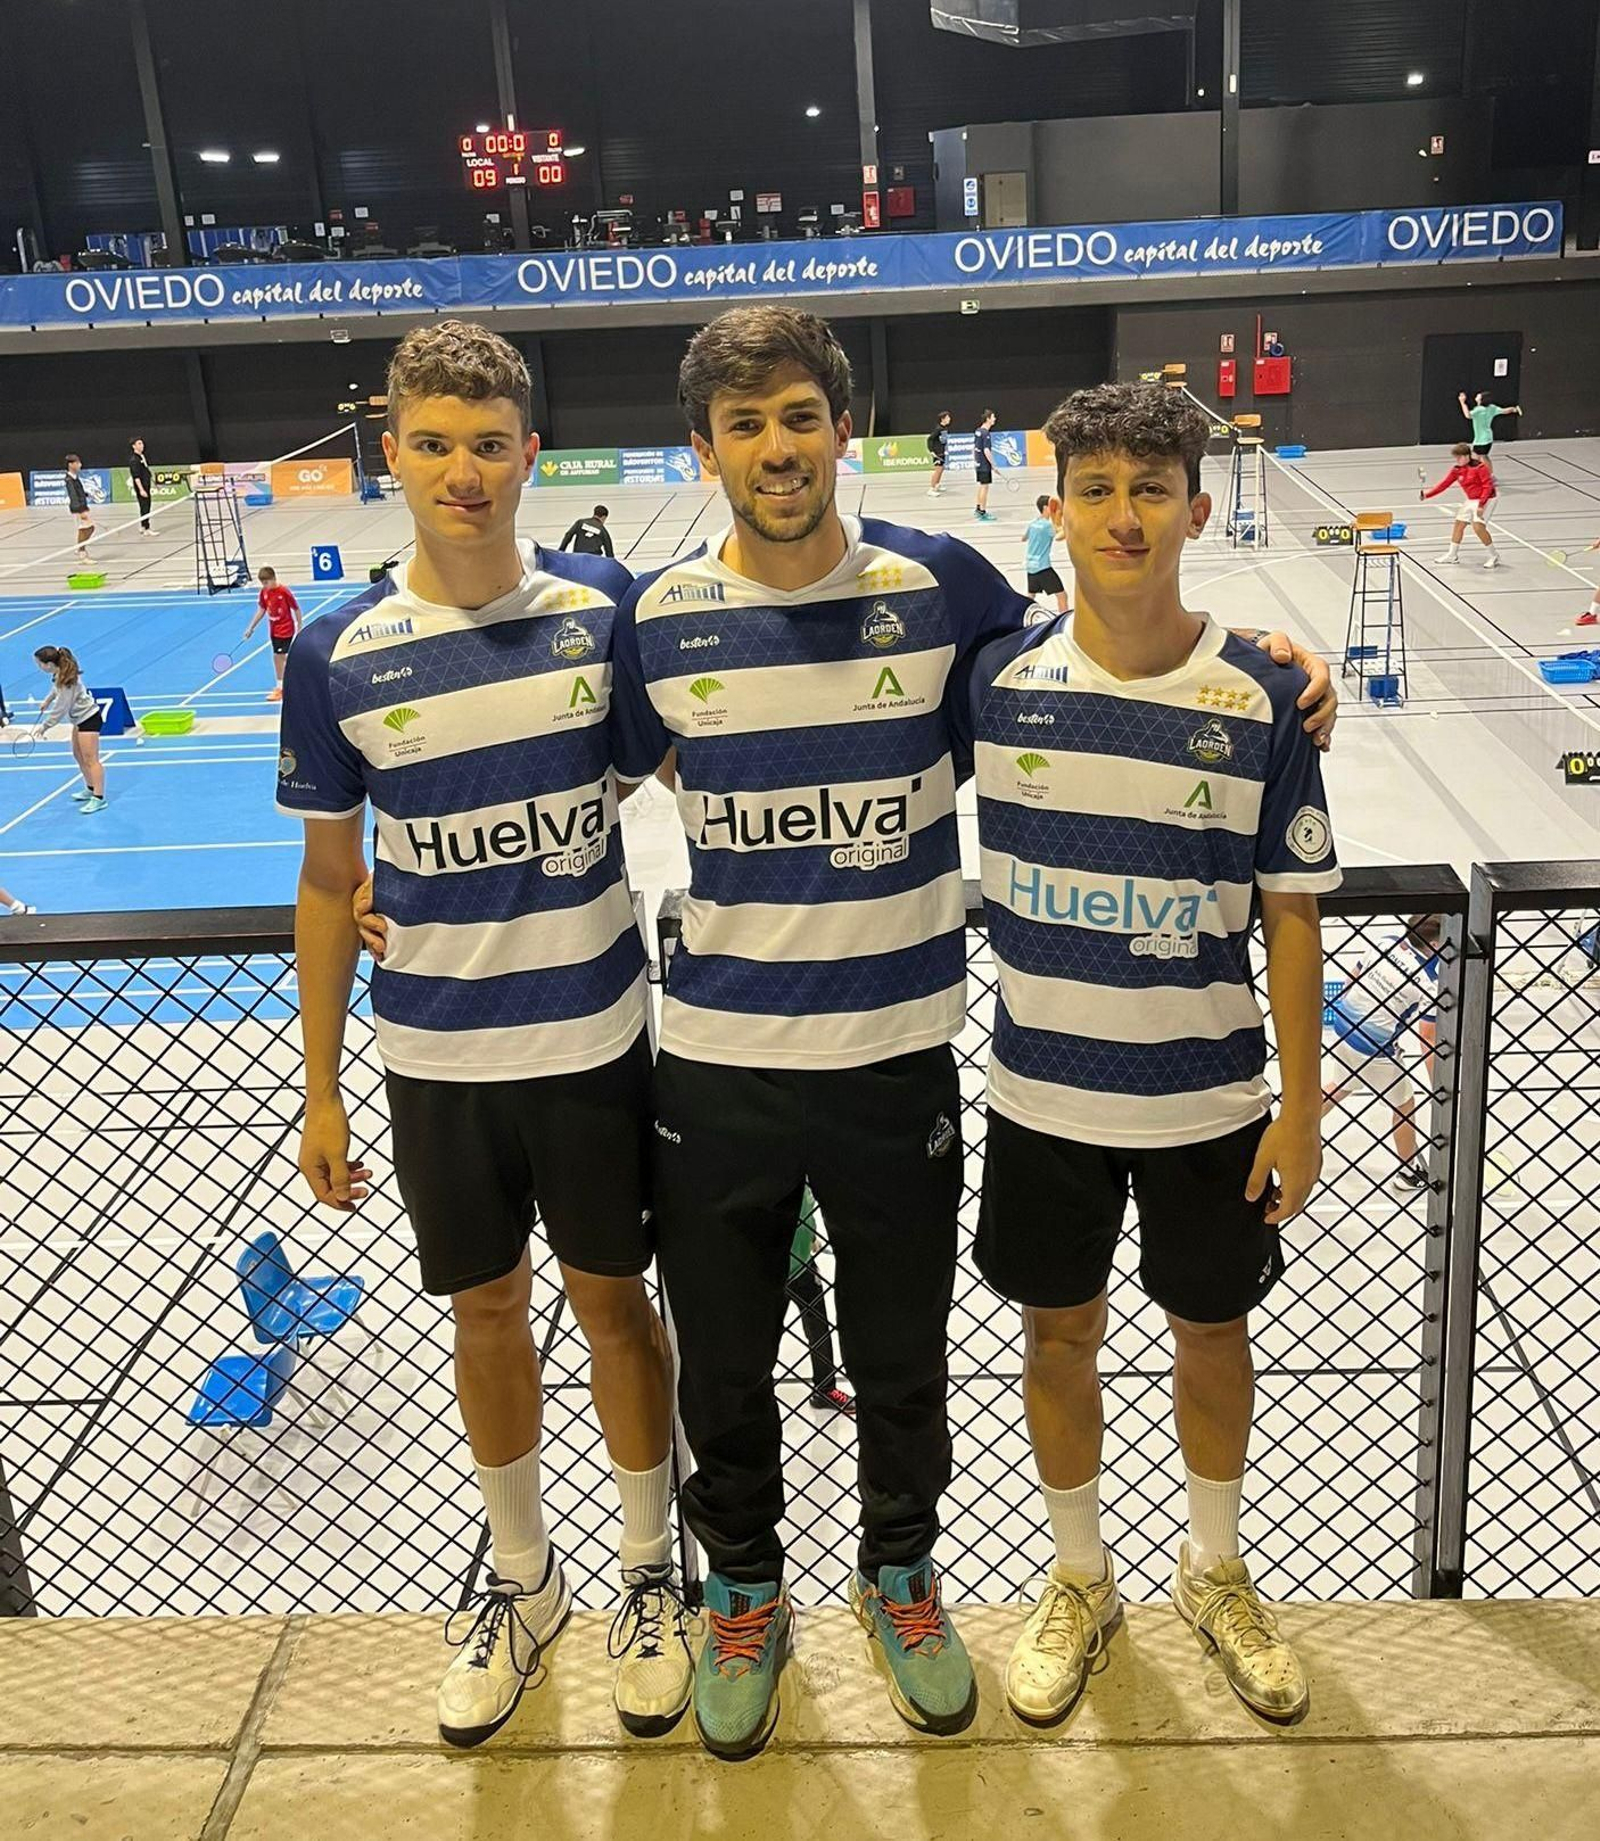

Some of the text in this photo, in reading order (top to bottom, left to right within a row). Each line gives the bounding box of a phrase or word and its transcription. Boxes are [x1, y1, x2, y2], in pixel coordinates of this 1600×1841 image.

[466, 158, 495, 167] LOCAL
[473, 169, 497, 187] 09
[539, 165, 562, 183] 00
[1387, 207, 1556, 251] OVIEDO
[953, 230, 1324, 274] OVIEDO capital del deporte
[517, 253, 879, 293] OVIEDO capital del deporte
[65, 273, 424, 313] OVIEDO capital del deporte
[584, 459, 617, 469] RURAL
[298, 469, 323, 483] GO
[1318, 529, 1328, 540] 0
[1341, 529, 1351, 540] 0
[318, 552, 332, 571] 6
[862, 622, 904, 640] LAORDEN
[96, 698, 113, 723] 7
[552, 712, 574, 722] Junta
[575, 709, 584, 717] de
[853, 702, 875, 711] Junta
[877, 701, 887, 709] de
[1570, 758, 1584, 775] 0
[701, 788, 907, 846] Huelva
[1164, 808, 1186, 817] Junta
[405, 797, 604, 870] Huelva
[545, 839, 604, 874] original
[834, 841, 906, 866] original
[1010, 859, 1201, 933] Huelva
[1132, 935, 1197, 957] origina
